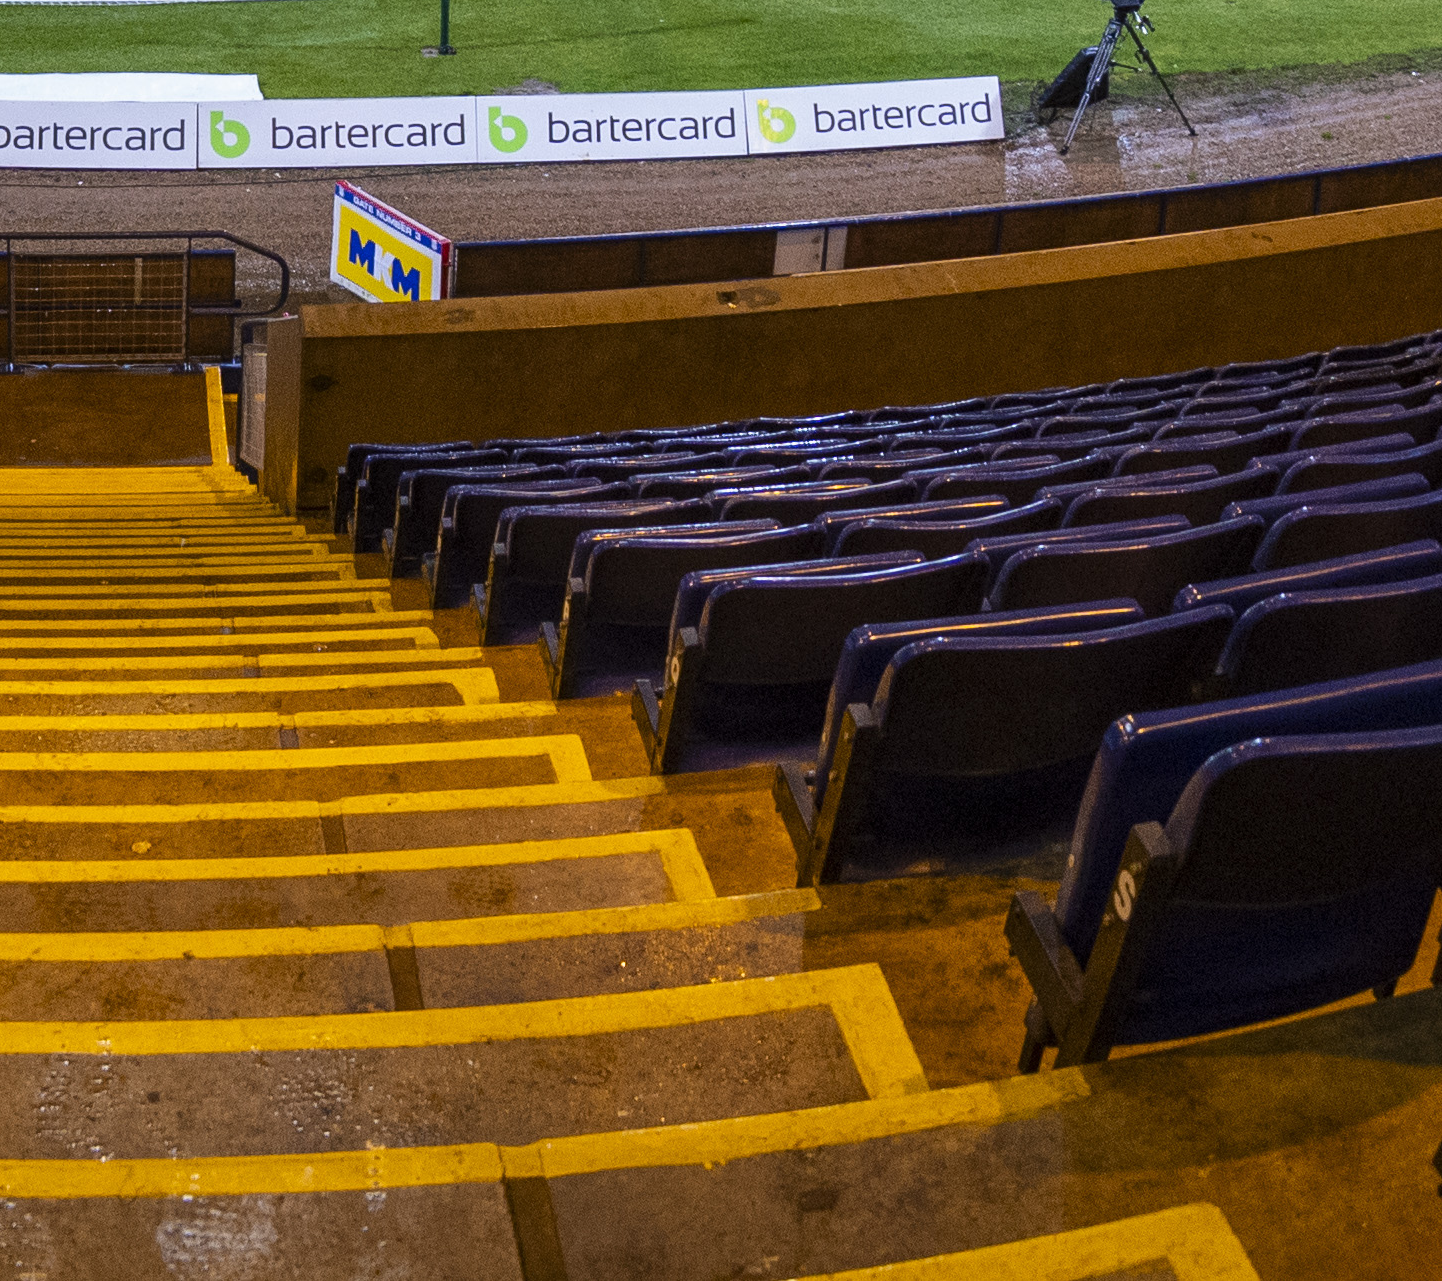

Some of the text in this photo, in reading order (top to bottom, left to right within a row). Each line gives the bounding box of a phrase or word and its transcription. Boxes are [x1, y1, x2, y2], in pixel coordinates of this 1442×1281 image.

[270, 115, 466, 151] bartercard
[547, 108, 736, 144] bartercard
[812, 93, 993, 135] bartercard
[352, 195, 374, 215] GATE
[376, 207, 412, 237] NUMBER
[348, 227, 421, 303] MKM
